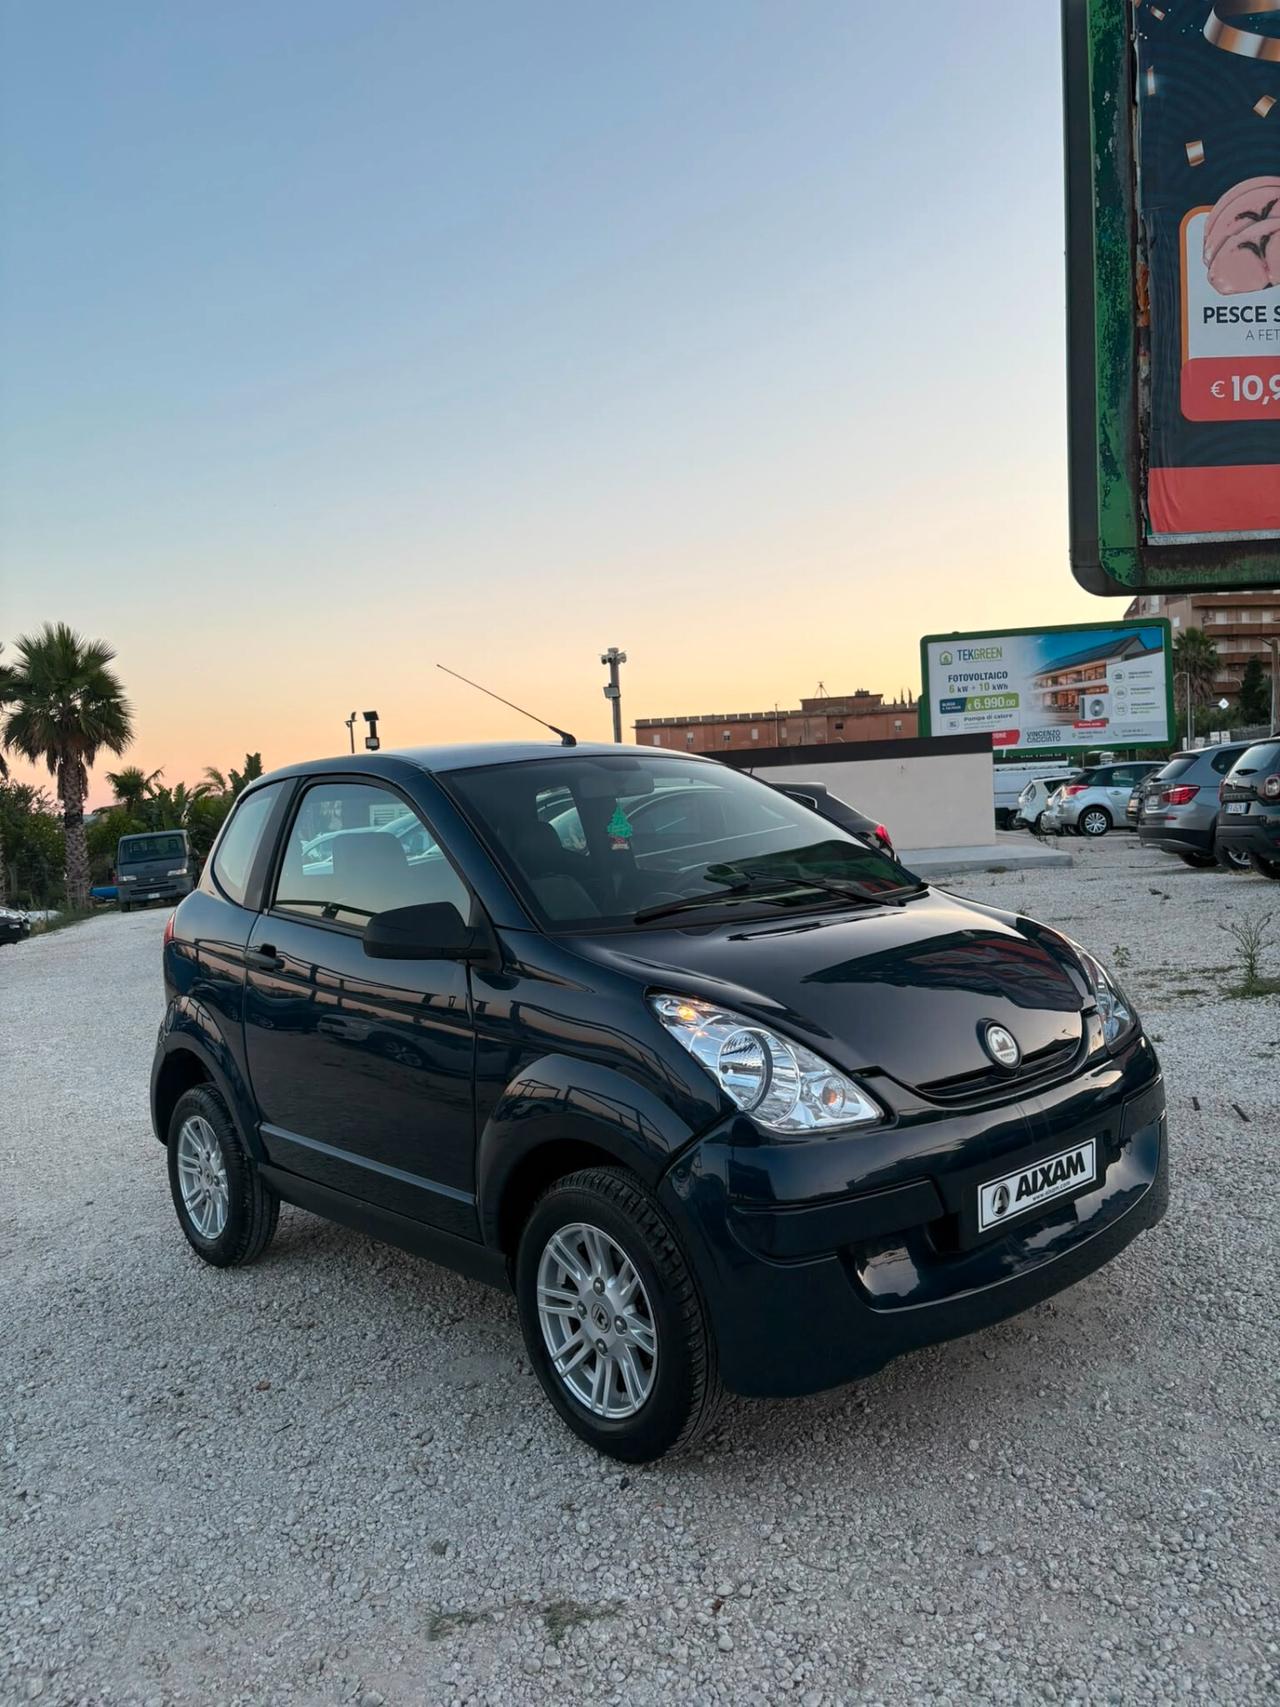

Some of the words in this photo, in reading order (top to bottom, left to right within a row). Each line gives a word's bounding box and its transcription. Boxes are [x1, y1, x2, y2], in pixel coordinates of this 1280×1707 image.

[1203, 306, 1267, 324] PESCE
[1245, 329, 1255, 341] A
[1258, 329, 1280, 341] FET
[1210, 380, 1225, 398] €
[957, 647, 1003, 661] TEKGREEN
[948, 671, 1008, 683] FOTOVOLTAICO
[949, 684, 955, 693] 6
[979, 682, 990, 691] 10
[1015, 1151, 1086, 1202] AIXAM
[1032, 1181, 1071, 1201] www.aixam.com
